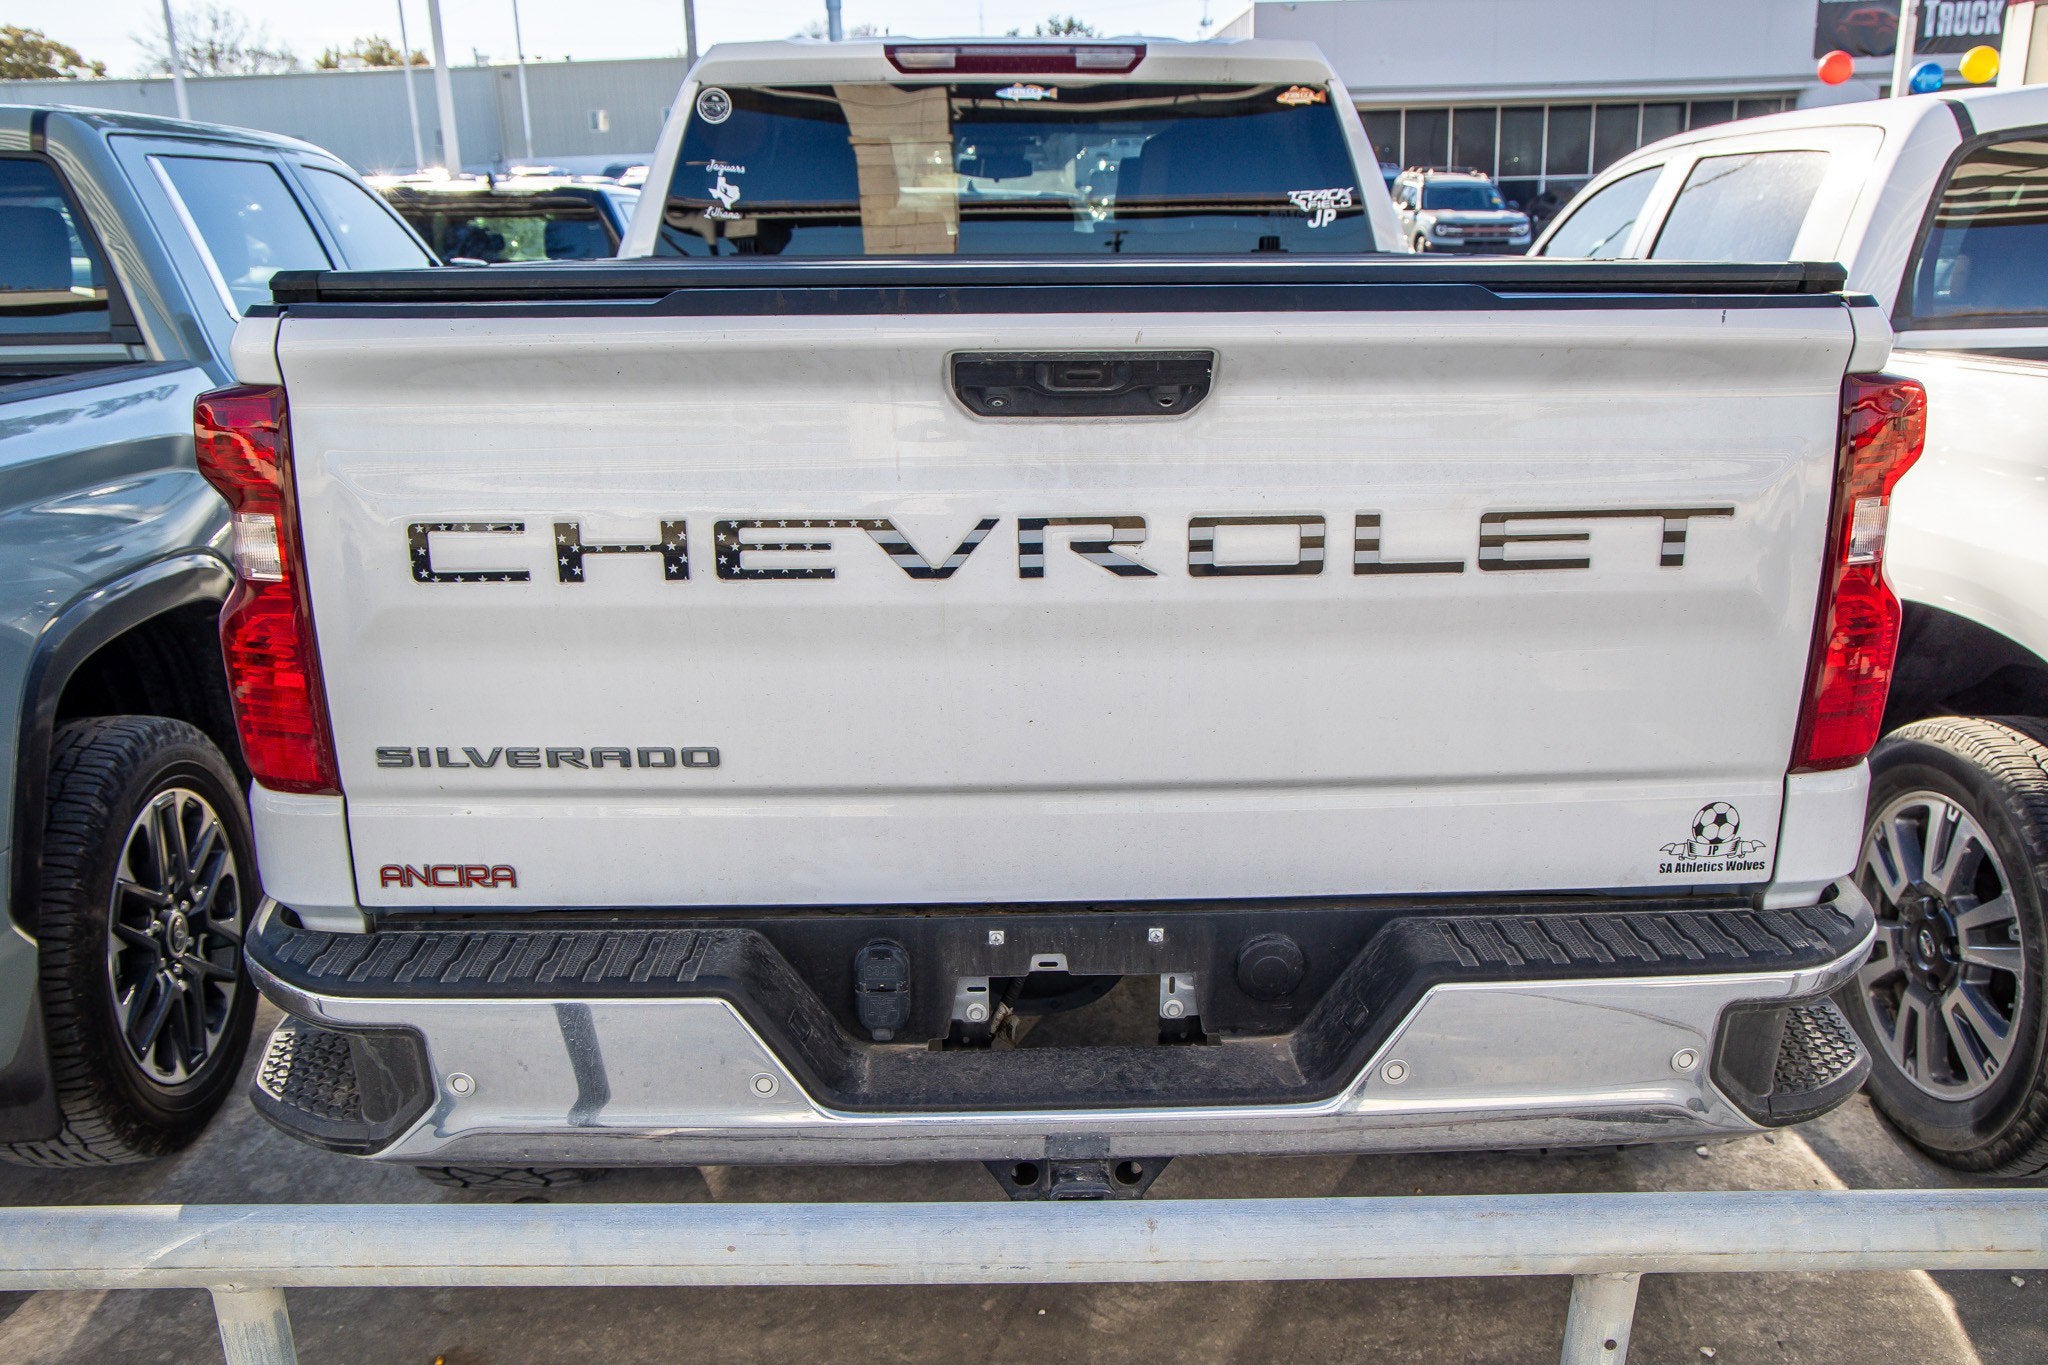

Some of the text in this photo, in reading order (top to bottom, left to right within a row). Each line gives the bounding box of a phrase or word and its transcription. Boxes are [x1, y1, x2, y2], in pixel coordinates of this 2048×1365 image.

[1923, 0, 2005, 38] TRUCK
[706, 159, 746, 177] Jaguars
[1307, 209, 1337, 228] JP
[407, 507, 1735, 583] CHEVROLET
[376, 746, 721, 769] SILVERADO
[1707, 845, 1719, 855] JP
[379, 864, 517, 888] ANCIRA
[1659, 860, 1765, 873] SA Athletics Wolves
